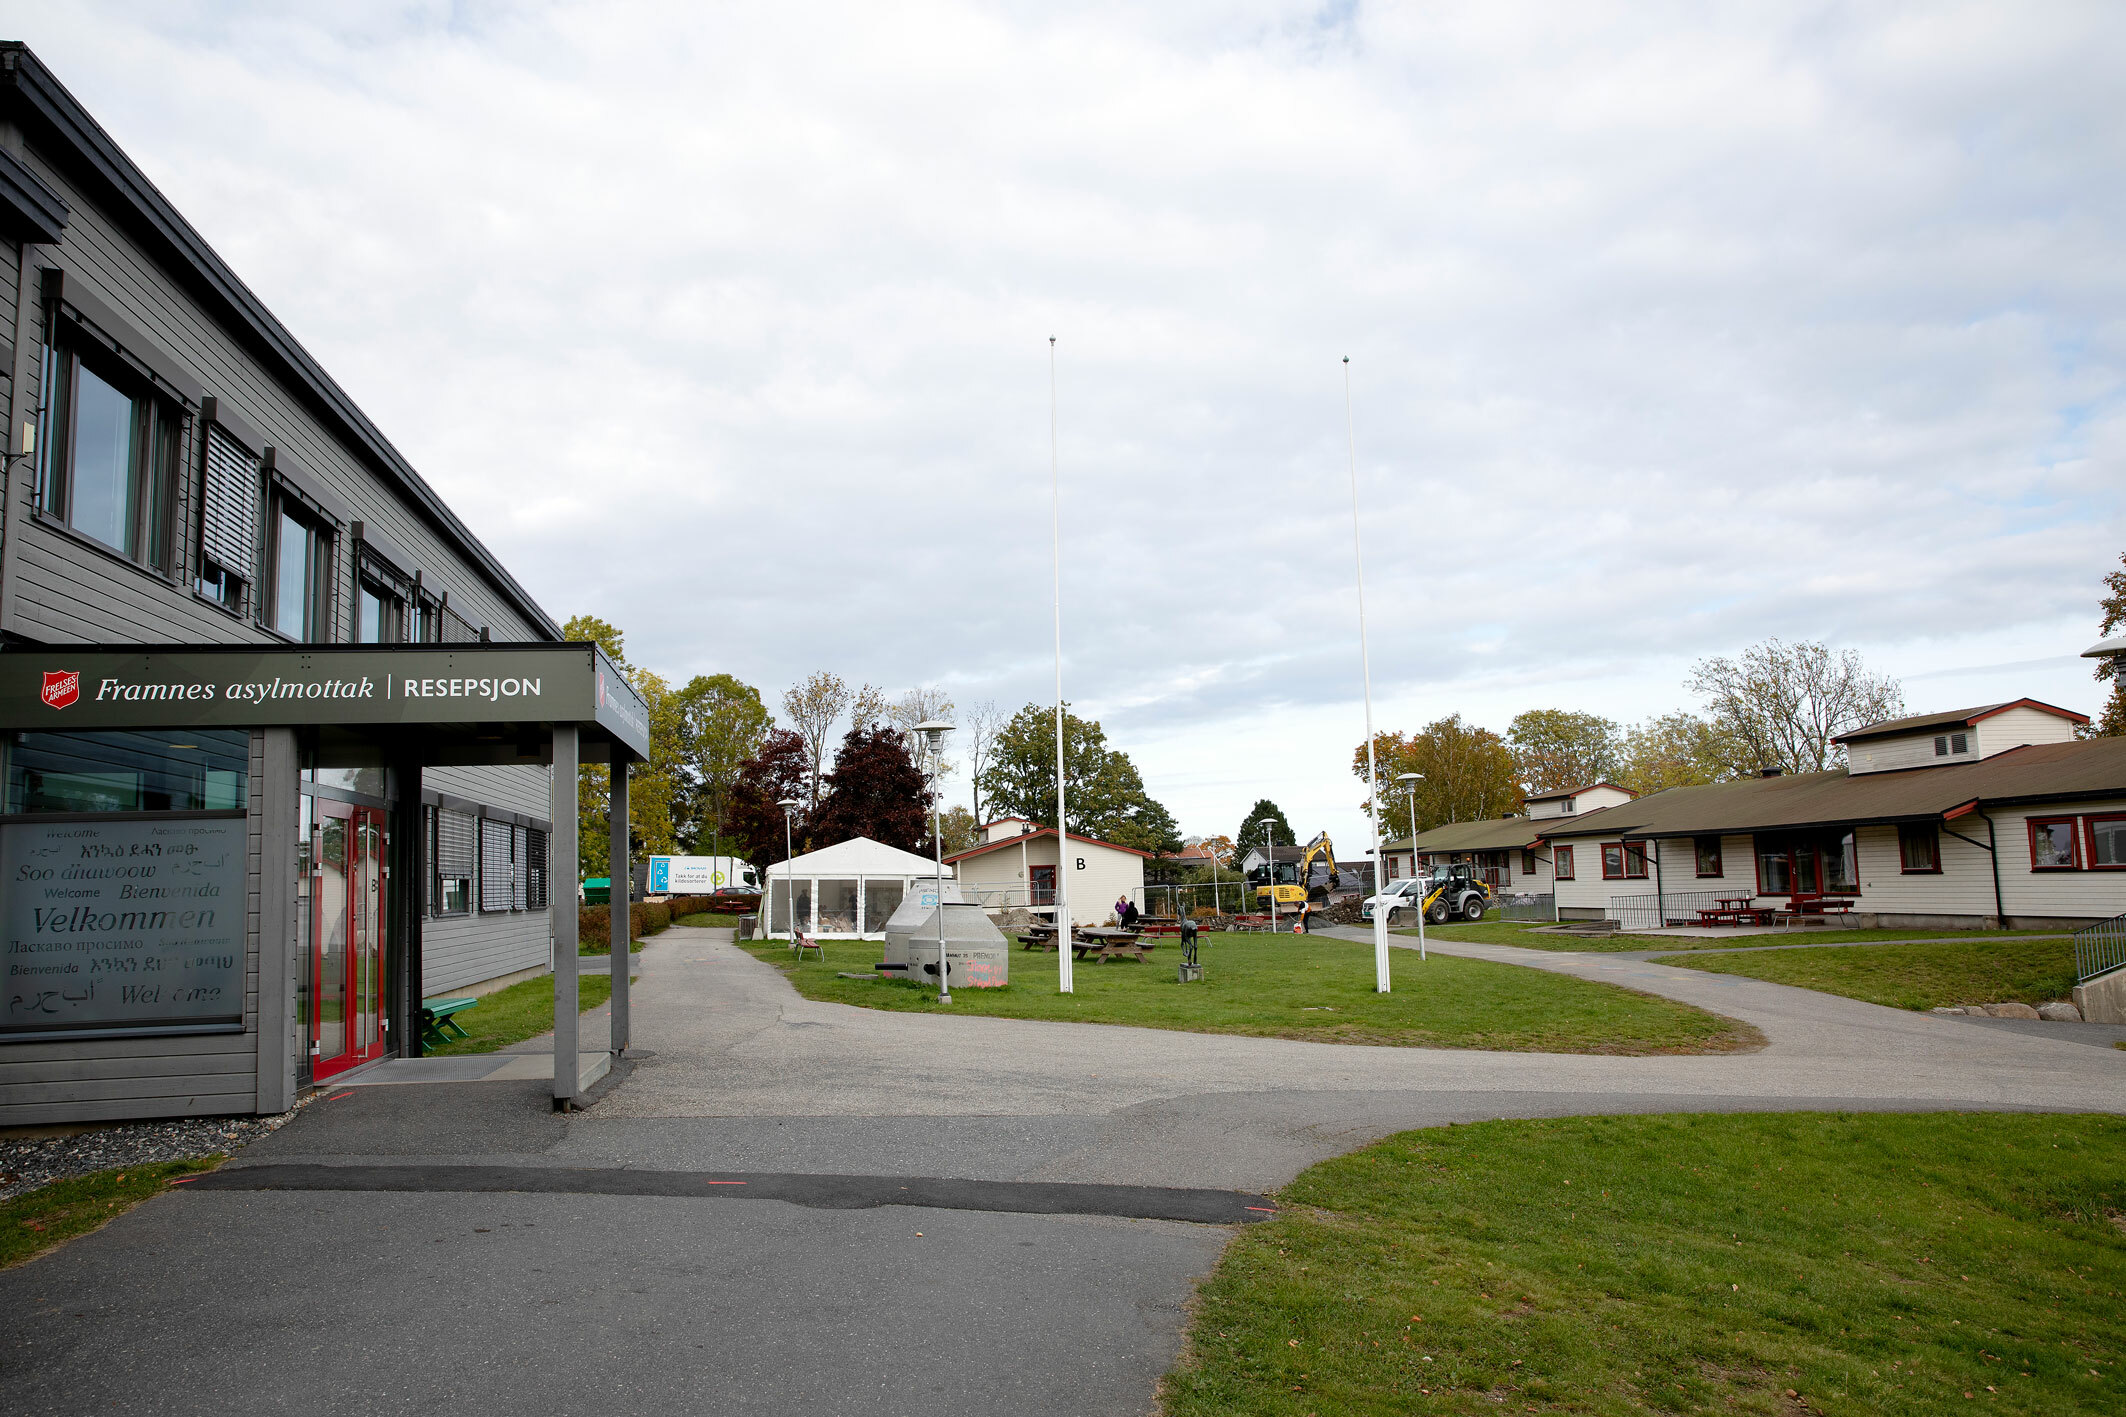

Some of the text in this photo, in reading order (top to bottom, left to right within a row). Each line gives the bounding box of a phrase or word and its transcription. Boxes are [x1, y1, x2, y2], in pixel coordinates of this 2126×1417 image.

[48, 683, 76, 702] ARMEEN
[95, 676, 374, 705] Framnes asylmottak
[404, 678, 541, 702] RESEPSJON
[1076, 857, 1086, 870] B
[16, 864, 55, 882] Soo
[44, 887, 101, 899] Welcome
[120, 883, 221, 900] Bienvenida
[34, 906, 216, 934] Velkommen
[8, 940, 72, 954] Ласкаво
[77, 939, 144, 955] просимо
[10, 962, 80, 976] Bienvenida
